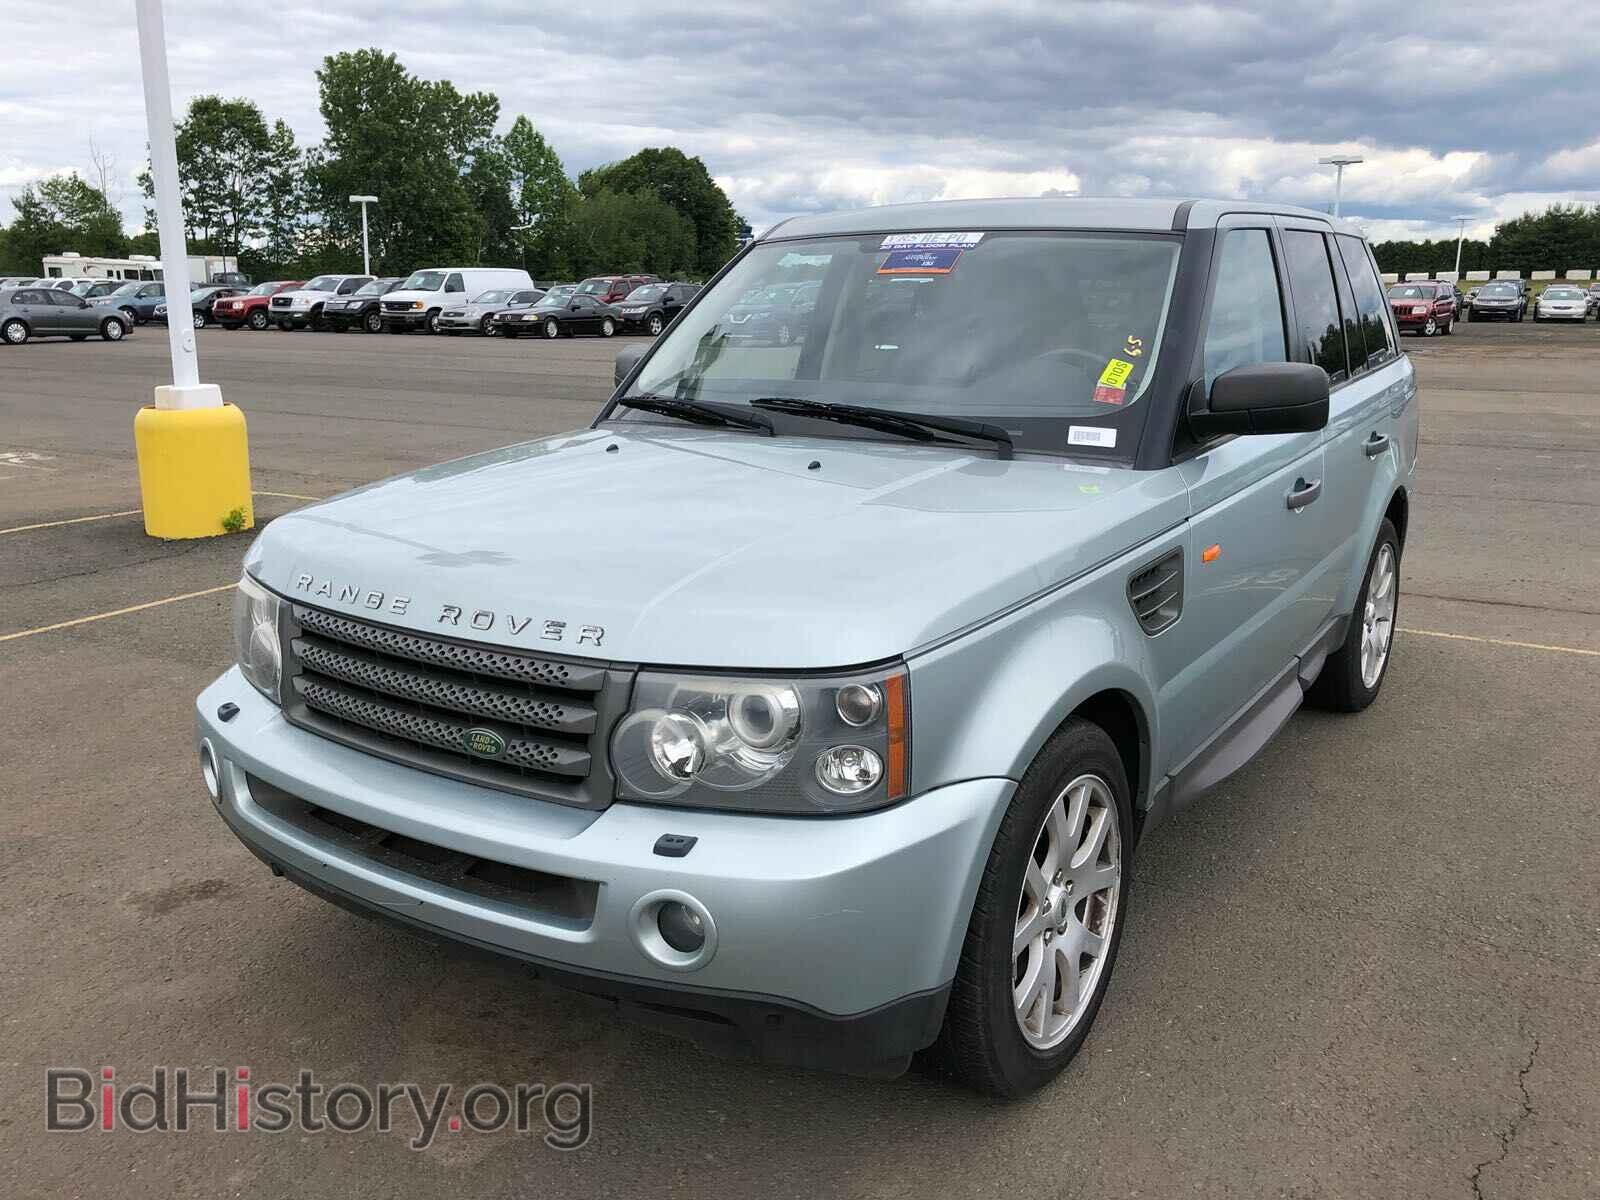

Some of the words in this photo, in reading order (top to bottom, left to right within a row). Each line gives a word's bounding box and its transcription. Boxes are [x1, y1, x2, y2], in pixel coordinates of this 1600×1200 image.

[1105, 361, 1128, 385] SOLD
[296, 573, 412, 616] RANGE
[438, 604, 606, 647] ROVER
[472, 734, 490, 744] LAND
[472, 742, 497, 753] ROVER
